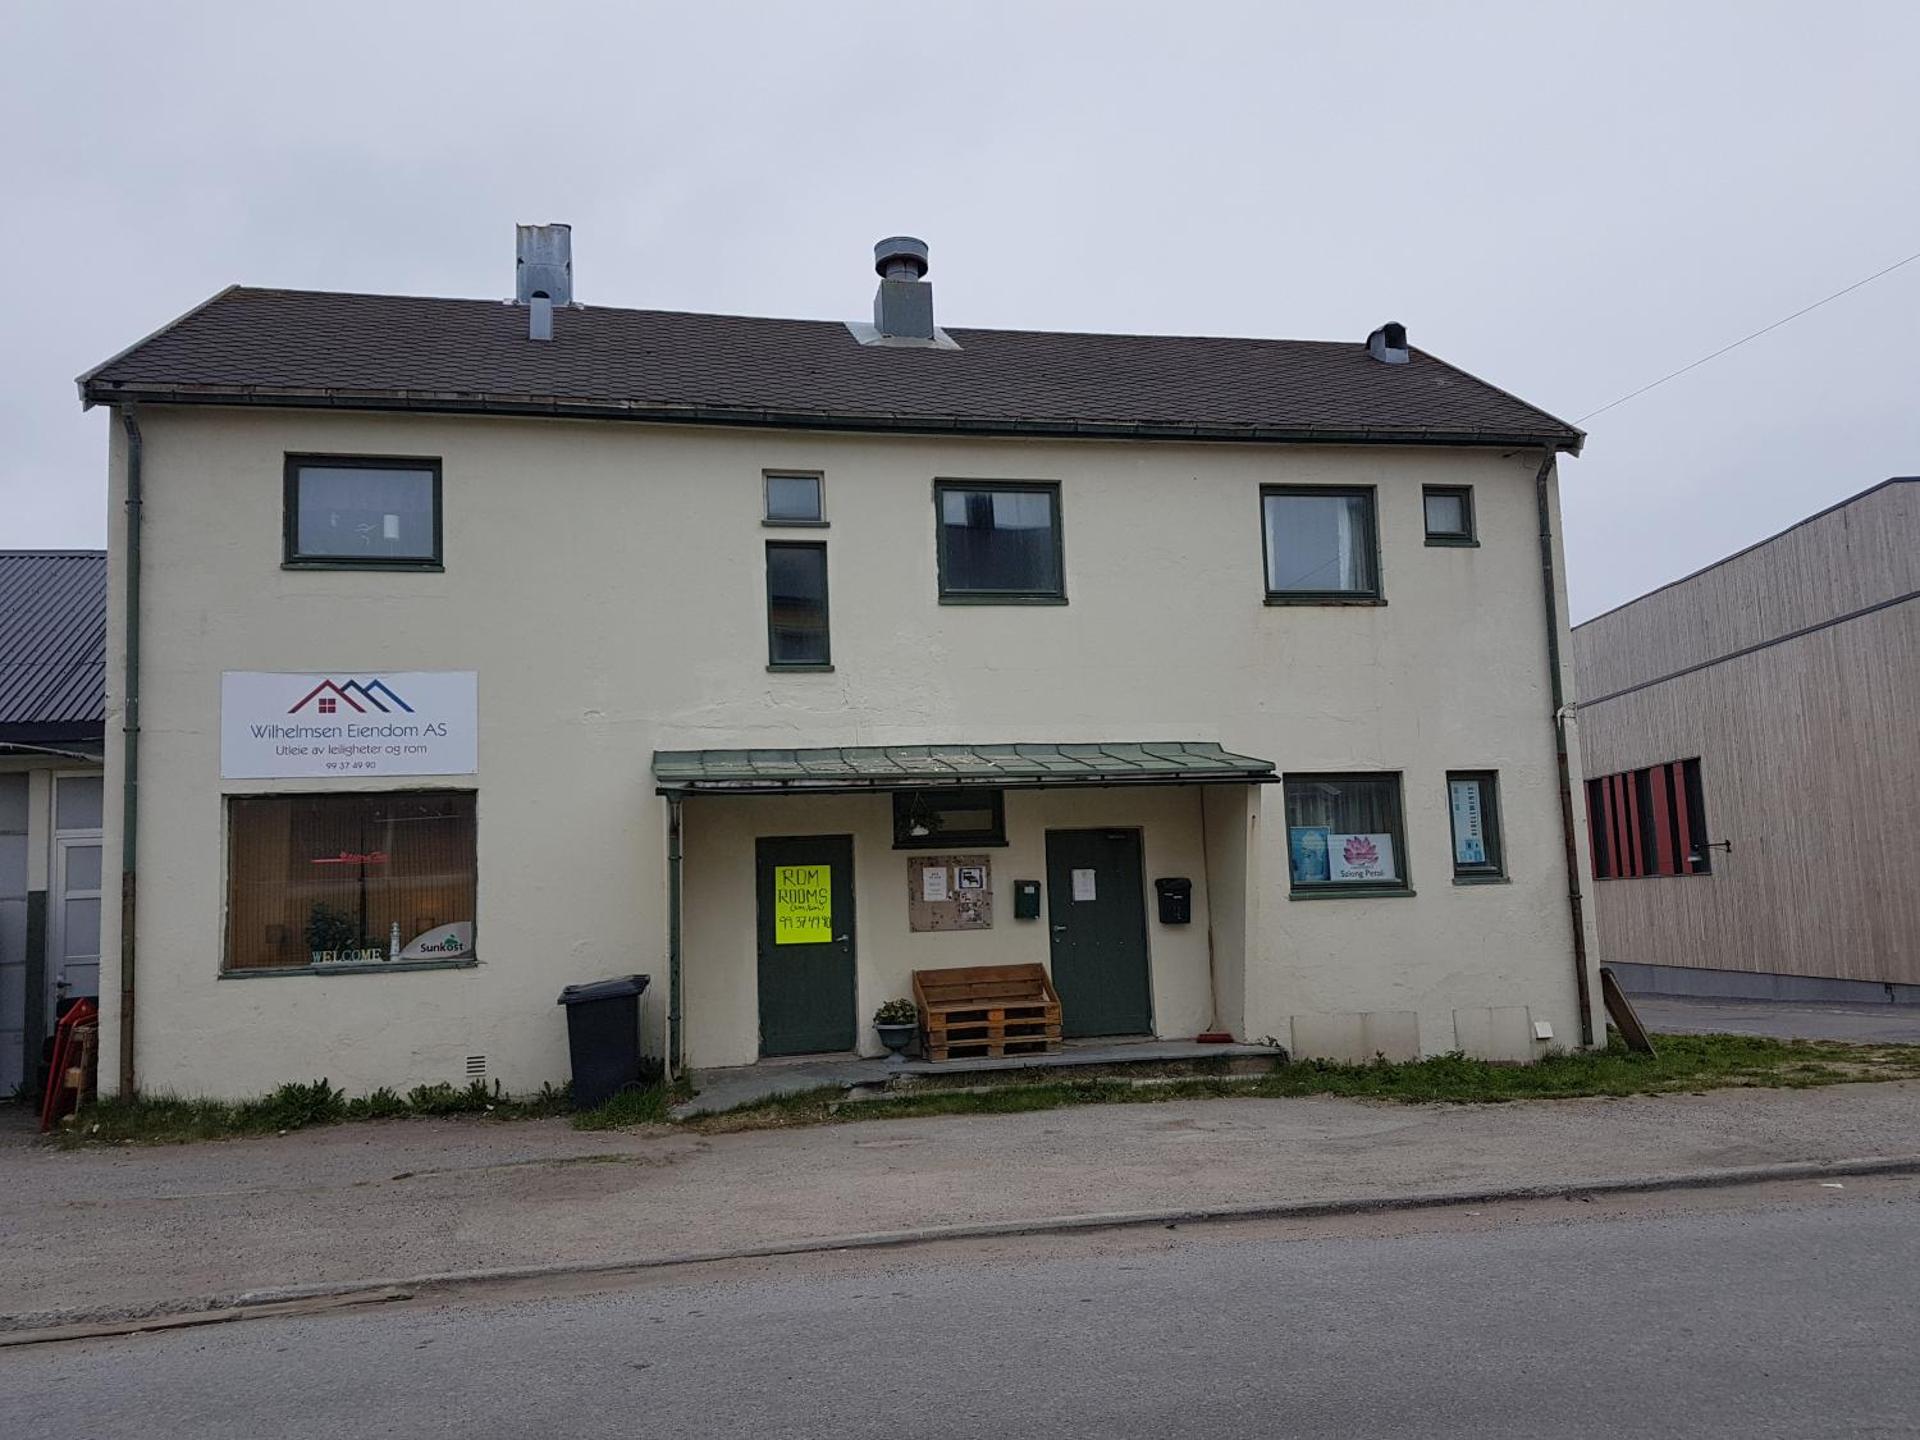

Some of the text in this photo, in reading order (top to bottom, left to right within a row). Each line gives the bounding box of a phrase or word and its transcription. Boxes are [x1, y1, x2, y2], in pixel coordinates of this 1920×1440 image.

[250, 722, 448, 740] Wilhelmsen Eiendom AS
[275, 743, 427, 757] Utleie av leiligheter og rom
[339, 762, 350, 770] 37
[783, 868, 819, 887] ROM
[778, 888, 828, 905] ROOMS
[420, 941, 464, 954] Sunkost
[311, 948, 382, 963] WELCOME
